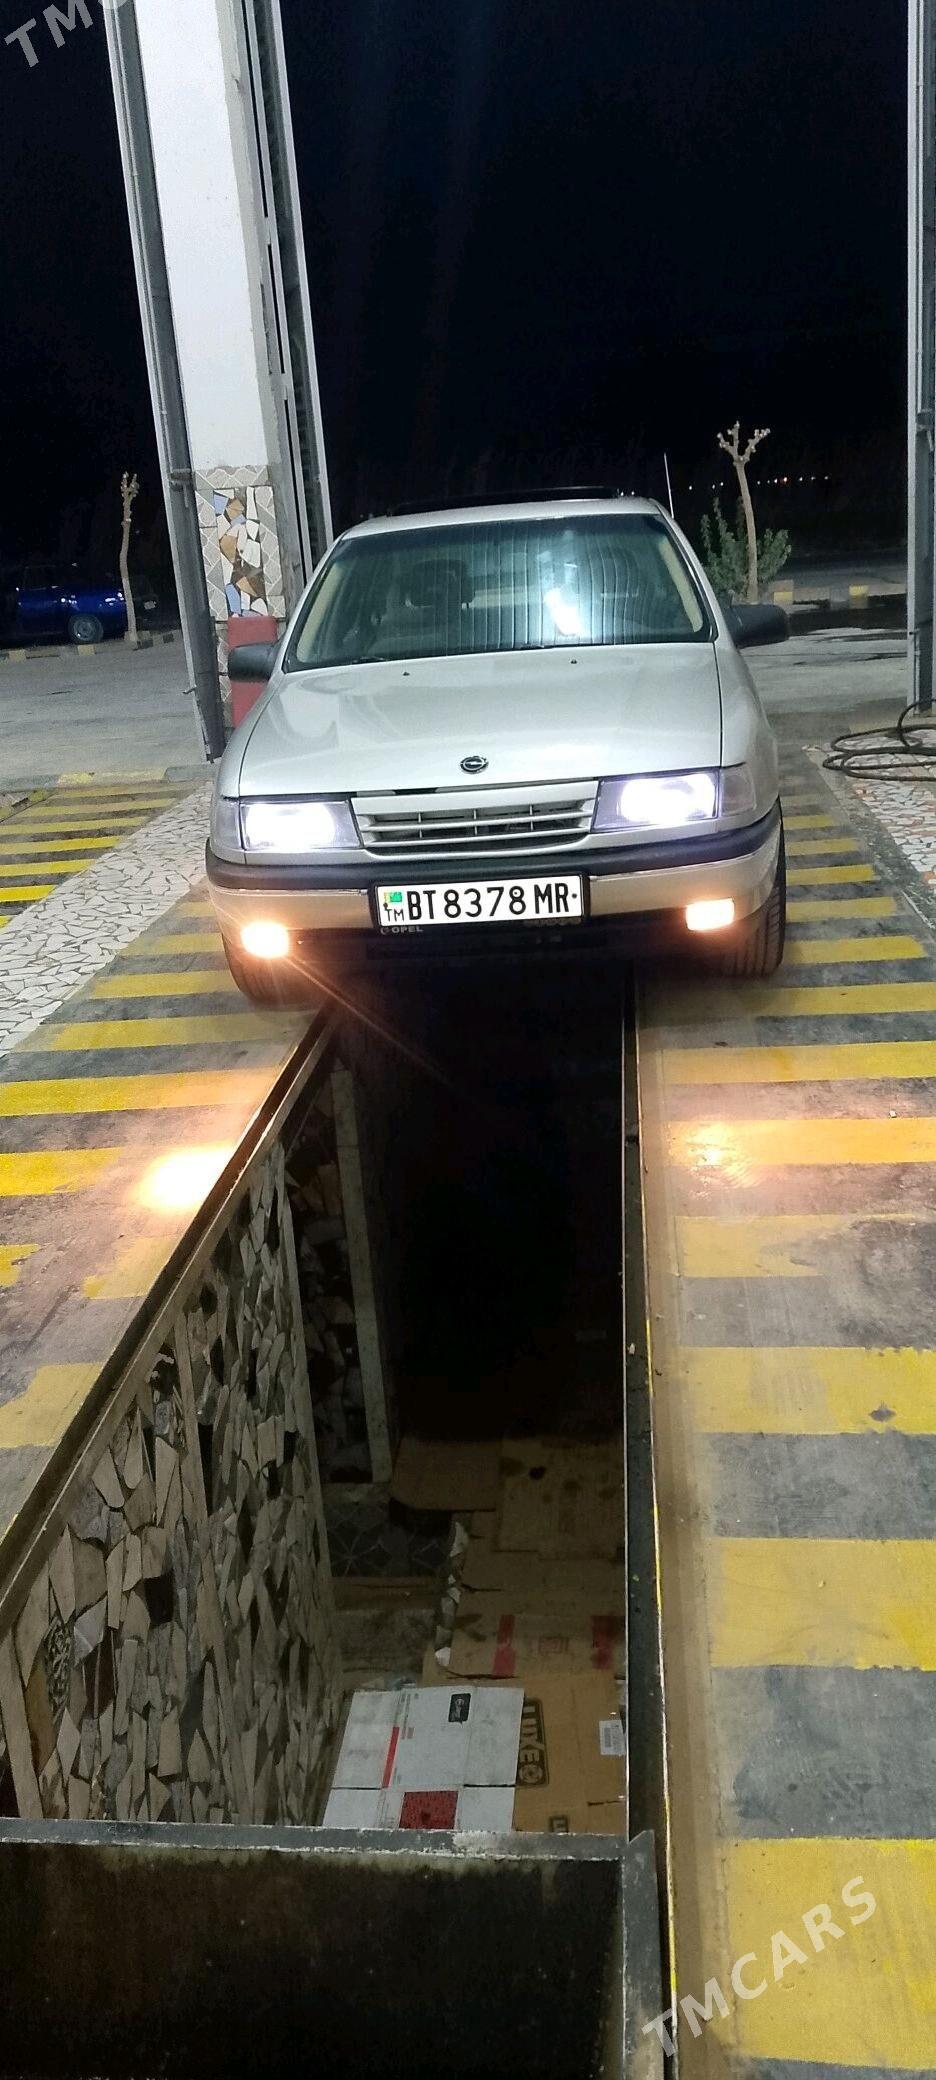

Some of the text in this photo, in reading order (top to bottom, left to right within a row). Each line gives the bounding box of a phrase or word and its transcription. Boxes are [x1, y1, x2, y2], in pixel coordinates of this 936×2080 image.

[407, 882, 569, 920] BT 8378 MR
[384, 908, 405, 922] TM
[391, 925, 424, 934] OPEL
